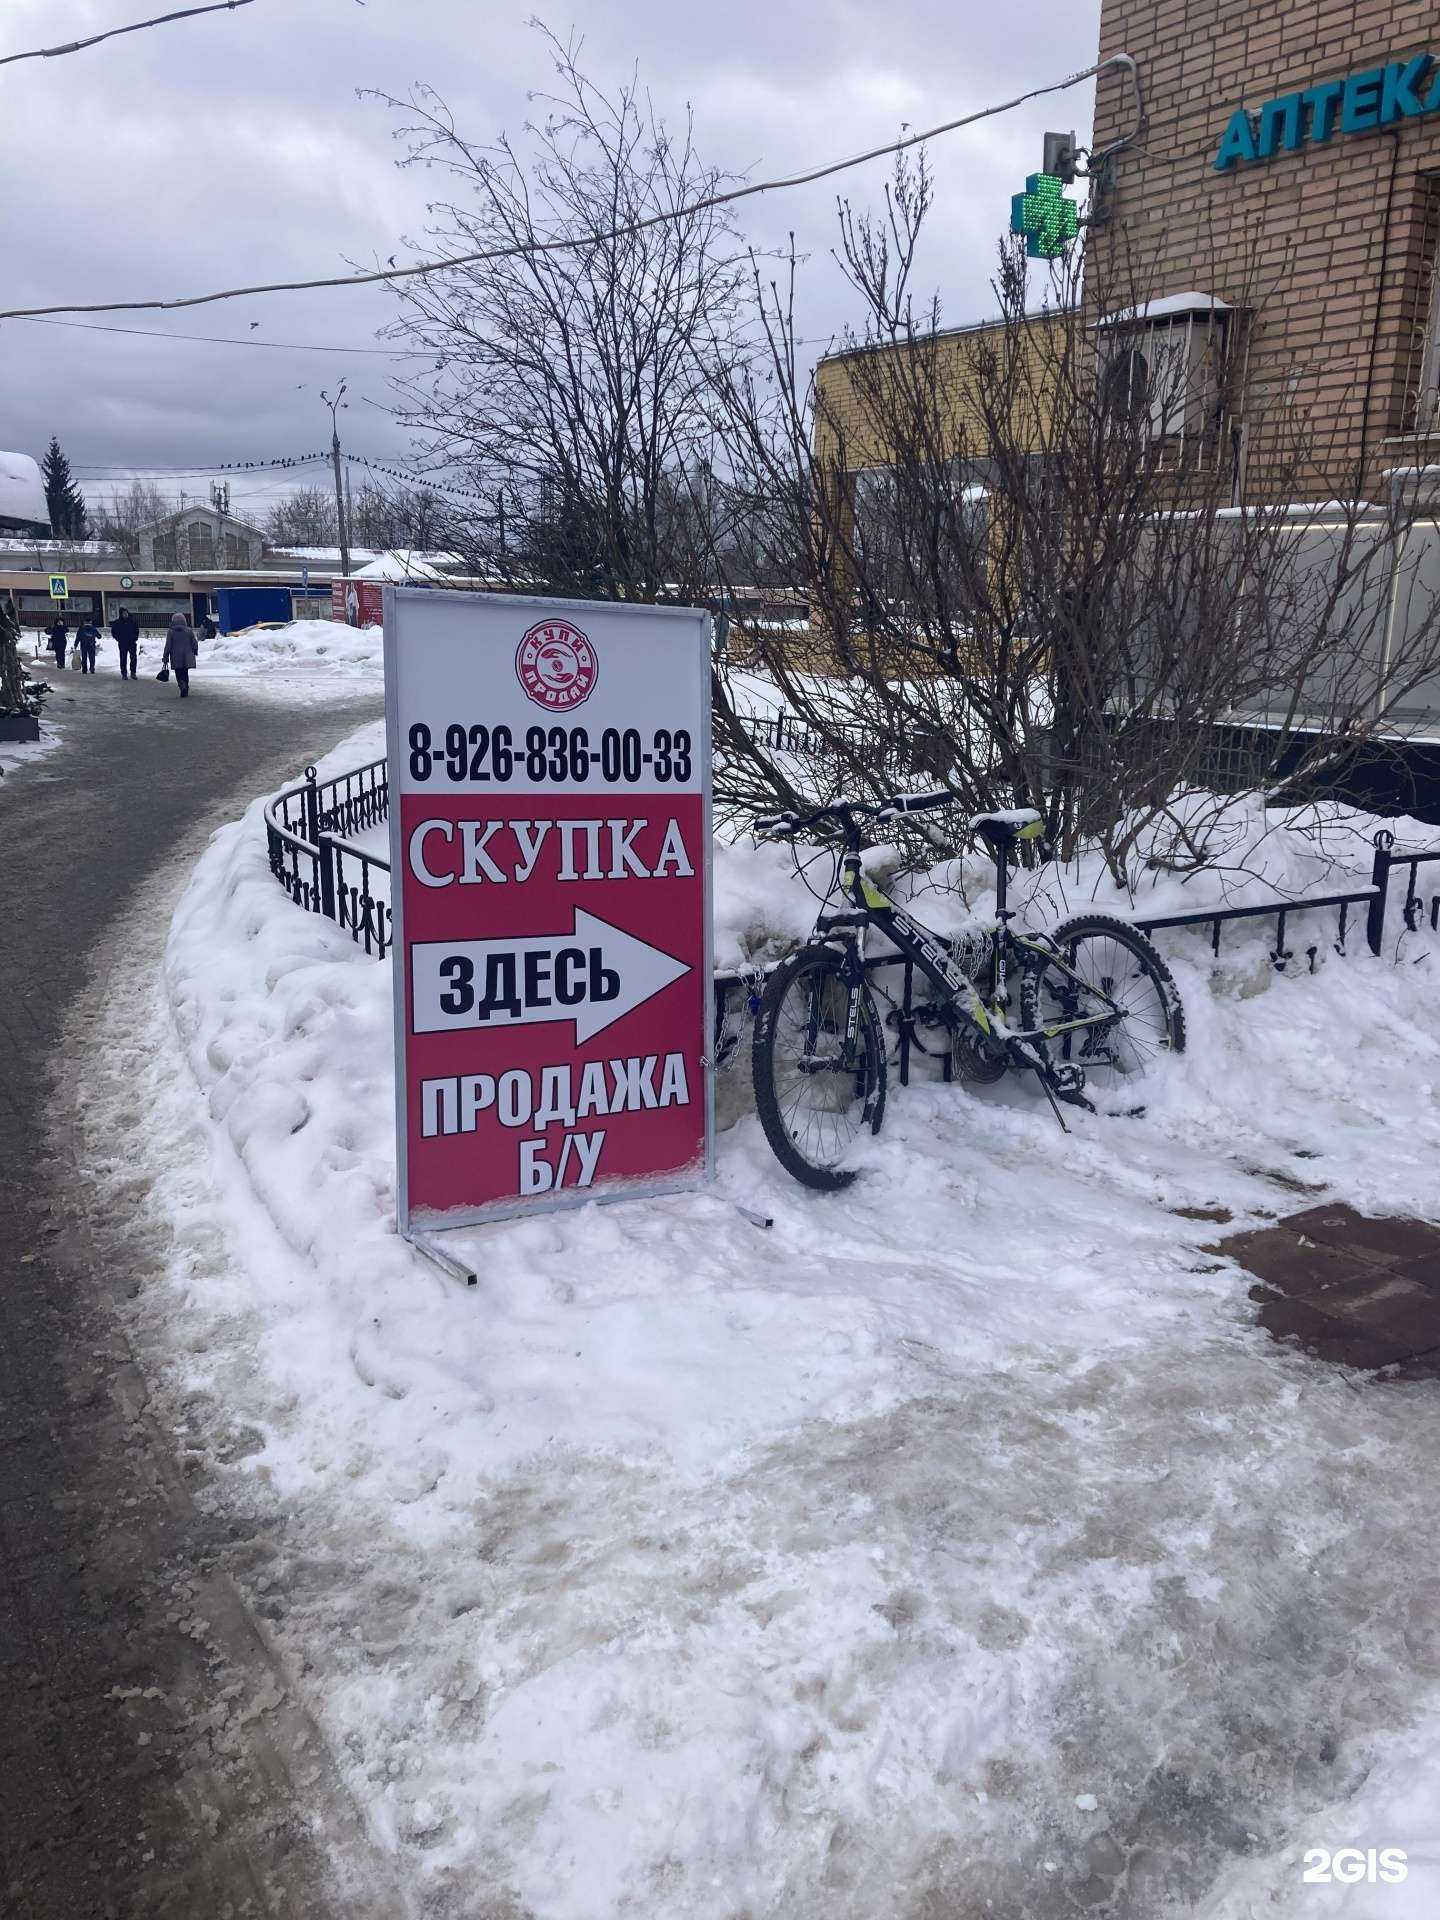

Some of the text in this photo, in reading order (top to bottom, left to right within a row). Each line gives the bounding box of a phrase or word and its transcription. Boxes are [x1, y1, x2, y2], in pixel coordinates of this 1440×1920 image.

[530, 628, 584, 653] КУПИ
[524, 670, 590, 704] ПРОДАЙ
[408, 722, 692, 784] 8-926-836-00-33
[408, 817, 695, 888] СКУПКА
[438, 946, 622, 1020] ЗДЕСЬ
[892, 915, 962, 990] STELS
[847, 987, 859, 1039] STELS
[421, 1051, 690, 1138] ПРОДАЖА
[518, 1128, 607, 1197] Б/У
